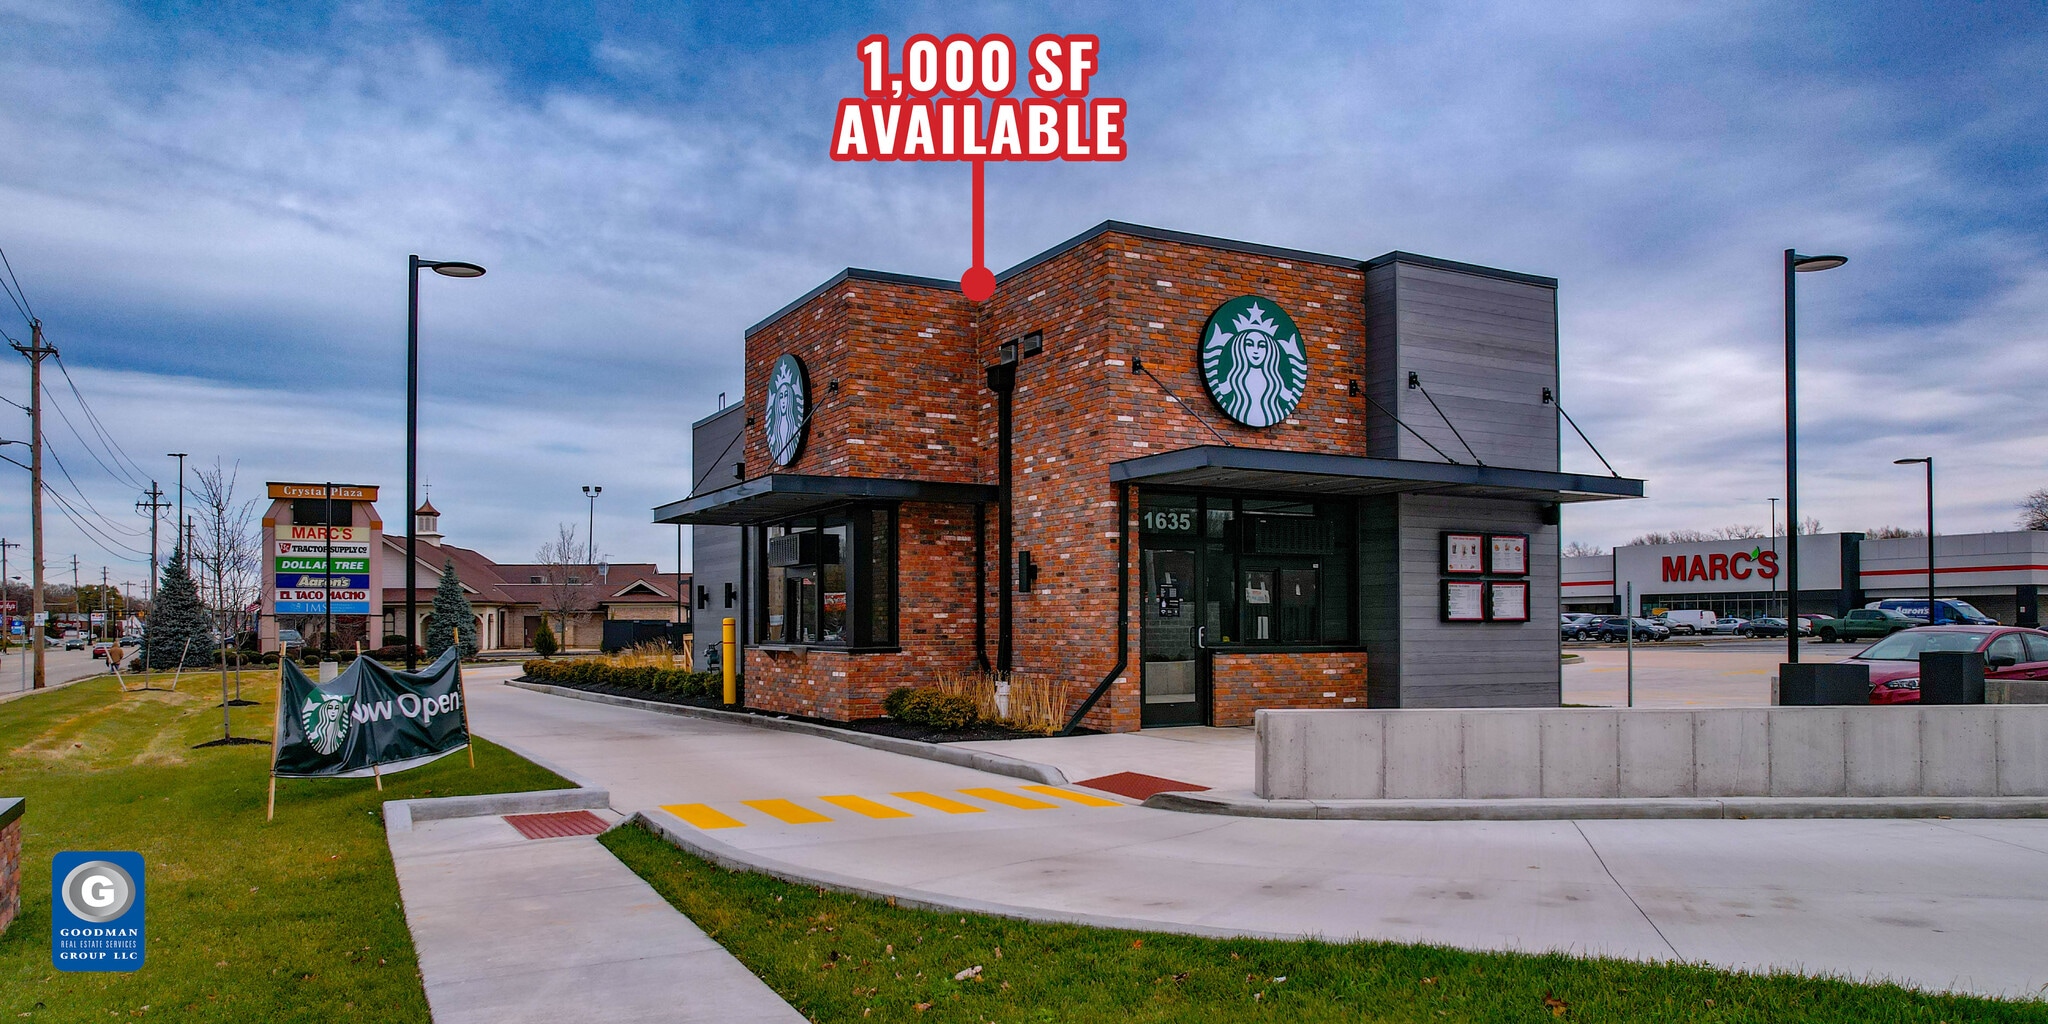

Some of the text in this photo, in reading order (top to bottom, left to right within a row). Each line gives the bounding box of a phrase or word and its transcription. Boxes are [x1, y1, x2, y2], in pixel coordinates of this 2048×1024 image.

[283, 486, 363, 497] Crystal Plaza
[1144, 511, 1191, 530] 1635
[291, 526, 353, 540] MARC'S
[335, 561, 364, 570] TREE
[1662, 547, 1779, 582] MARC'S
[295, 590, 324, 600] TACO
[397, 690, 460, 723] Open
